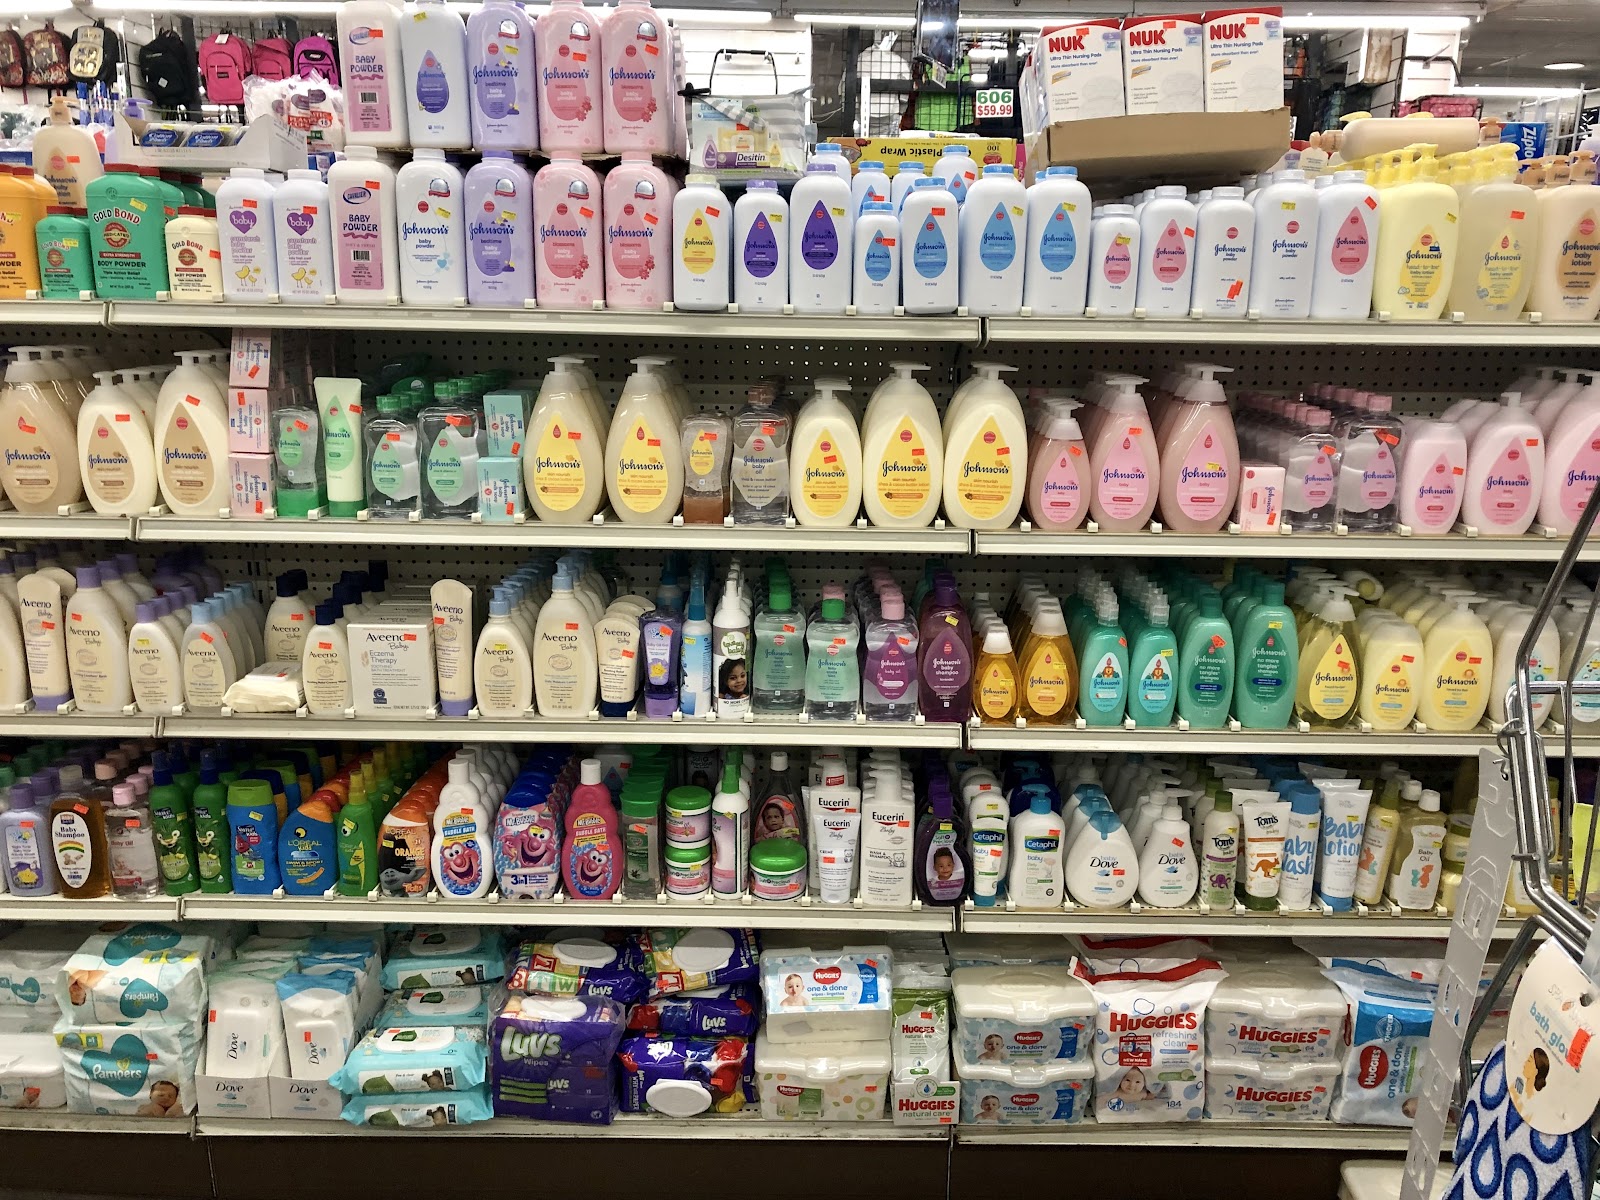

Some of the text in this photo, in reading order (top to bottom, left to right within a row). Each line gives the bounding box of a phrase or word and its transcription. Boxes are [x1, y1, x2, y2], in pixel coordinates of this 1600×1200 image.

[1210, 23, 1247, 40] NUK
[1048, 34, 1085, 53] NUK
[1129, 30, 1166, 47] NUK
[356, 55, 375, 63] BABY
[350, 64, 384, 73] POWDER
[473, 66, 519, 84] Johnson's
[543, 67, 590, 85] Johnson's
[609, 69, 656, 86] Johnson's
[977, 90, 1012, 105] 606
[977, 105, 1012, 116] $59.99
[737, 152, 766, 162] Desitin
[880, 148, 907, 156] Wrap
[93, 207, 141, 224] GOLD BOND
[349, 214, 370, 222] BABY
[233, 217, 255, 229] baby
[290, 218, 312, 230] baby
[343, 223, 378, 232] POWDER
[403, 222, 448, 240] Johnson's
[469, 222, 514, 239] Johnson's
[540, 225, 587, 243] Johnson's
[608, 225, 653, 243] Johnson's
[172, 240, 203, 252] GOLD BOND
[684, 237, 713, 249] Johnson's
[1272, 239, 1308, 252] Johnson's
[1214, 244, 1246, 256] Johnson's
[1574, 252, 1591, 260] baby
[1406, 250, 1442, 263] Johnson's
[1485, 253, 1520, 265] Johnson's
[5, 449, 51, 465] Johnson's
[88, 454, 128, 470] Johnson's
[164, 448, 207, 464] Johnson's
[535, 457, 581, 472] Johnson's
[619, 459, 664, 475] Johnson's
[882, 460, 927, 477] Johnson's
[963, 462, 1010, 478] Johnson's
[805, 468, 845, 482] Johnson's
[1103, 468, 1146, 483] Johnson's
[1181, 467, 1227, 483] Johnson's
[1044, 481, 1079, 492] Johnson's
[1486, 476, 1530, 490] Johnson's
[1419, 486, 1454, 498] Johnson's
[21, 598, 52, 609] Aveeno
[432, 603, 464, 614] Aveeno
[449, 615, 464, 624] Baby
[69, 626, 100, 637] Aveeno
[271, 624, 300, 633] Aveeno
[602, 628, 631, 637] Aveeno
[541, 633, 578, 642] Aveeno
[387, 642, 409, 651] Baby
[483, 648, 514, 656] Aveeno
[559, 643, 578, 652] Baby
[187, 649, 216, 657] Aveeno
[308, 651, 337, 659] Aveeno
[1252, 647, 1286, 659] Johnson's
[933, 658, 961, 668] Johnson's
[1194, 655, 1227, 666] Johnson's
[1029, 676, 1065, 687] Johnson's
[1437, 675, 1478, 687] Johnson's
[1375, 684, 1410, 694] Johnson's
[818, 798, 850, 808] Eucerin
[823, 819, 851, 827] Eucerin
[872, 812, 904, 822] Eucerin
[1254, 815, 1279, 827] Tom's
[444, 827, 462, 836] BUBBLE
[972, 832, 1004, 842] Cetaphil
[1026, 840, 1057, 850] Cetaphil
[1212, 836, 1235, 848] Tom's
[395, 848, 425, 857] ORANGE
[973, 847, 989, 856] baby
[1027, 854, 1043, 863] baby
[1090, 858, 1119, 869] Dove
[1158, 855, 1186, 865] Dove
[815, 972, 840, 980] HUGGIES
[588, 984, 613, 996] Luvs
[124, 992, 158, 1002] Pampers
[702, 1014, 726, 1030] Luvs
[1109, 1012, 1197, 1033] HUGGIES
[1384, 1013, 1394, 1043] THICKER
[902, 1024, 935, 1033] HUGGIES
[1239, 1025, 1318, 1043] HUGGIES
[1016, 1034, 1042, 1042] HUGGIES
[1152, 1030, 1197, 1040] refreshing
[227, 1032, 239, 1060] Dove
[501, 1025, 561, 1062] Luvs
[1163, 1039, 1187, 1048] clean
[308, 1042, 319, 1065] Dove
[92, 1063, 142, 1080] Pampers
[1364, 1049, 1381, 1086] HUGGIES
[1387, 1080, 1396, 1099] one
[1394, 1041, 1405, 1069] done
[215, 1082, 244, 1092] Dove
[289, 1084, 318, 1095] Dove
[1236, 1086, 1312, 1102] HUGGIES
[898, 1099, 955, 1111] HUGGIES
[1166, 1100, 1182, 1108] 184
